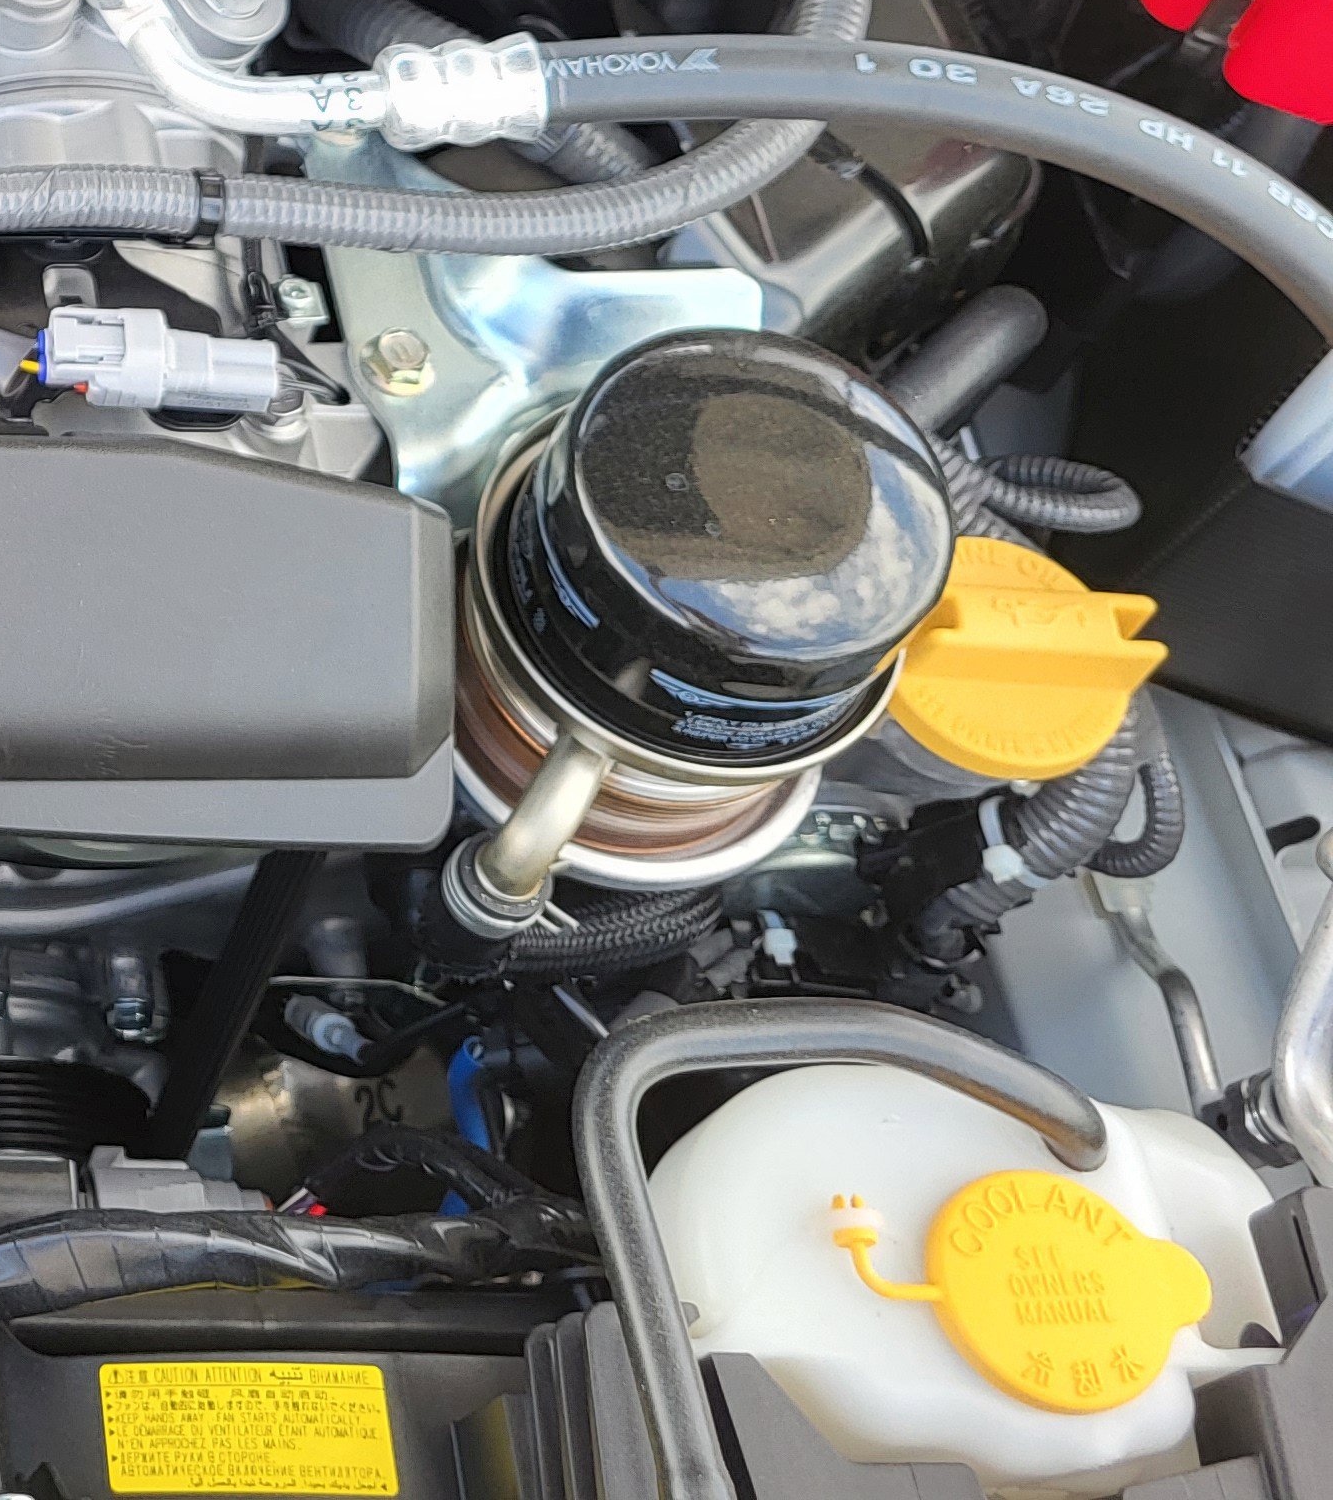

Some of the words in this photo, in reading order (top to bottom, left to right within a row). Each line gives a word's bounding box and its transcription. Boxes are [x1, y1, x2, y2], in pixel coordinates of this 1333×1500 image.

[854, 52, 878, 74] 1
[908, 58, 978, 86] 30
[1010, 75, 1109, 118] 26A
[1137, 117, 1195, 152] HP
[1211, 148, 1246, 178] 11
[949, 1180, 1133, 1258] COOLANT
[1016, 1297, 1117, 1326] MANUAL
[153, 1367, 199, 1384] CAUTION
[204, 1366, 262, 1384] ATTENTION
[308, 1368, 371, 1386] ВНИМАНИЕ
[116, 1412, 139, 1424] KEEP
[144, 1412, 175, 1424] HANDS
[216, 1412, 235, 1423] FAN
[239, 1412, 278, 1425] STARTS
[117, 1424, 129, 1438] LE
[190, 1424, 204, 1437] DU
[208, 1423, 273, 1437] VENTILATEUR
[149, 1437, 208, 1450] APPROCHEZ
[212, 1437, 233, 1450] PAS
[237, 1438, 259, 1450] LES
[262, 1438, 302, 1451] MAINS.
[119, 1451, 171, 1465] ДЕРЖИТЕ
[174, 1451, 204, 1464] РУКИ
[218, 1451, 276, 1464] СТОРОНЕ.
[120, 1464, 224, 1478] АВТОМАТИЧЕСКОЕ
[228, 1464, 295, 1478] ВКЛЮЧЕНИЕ
